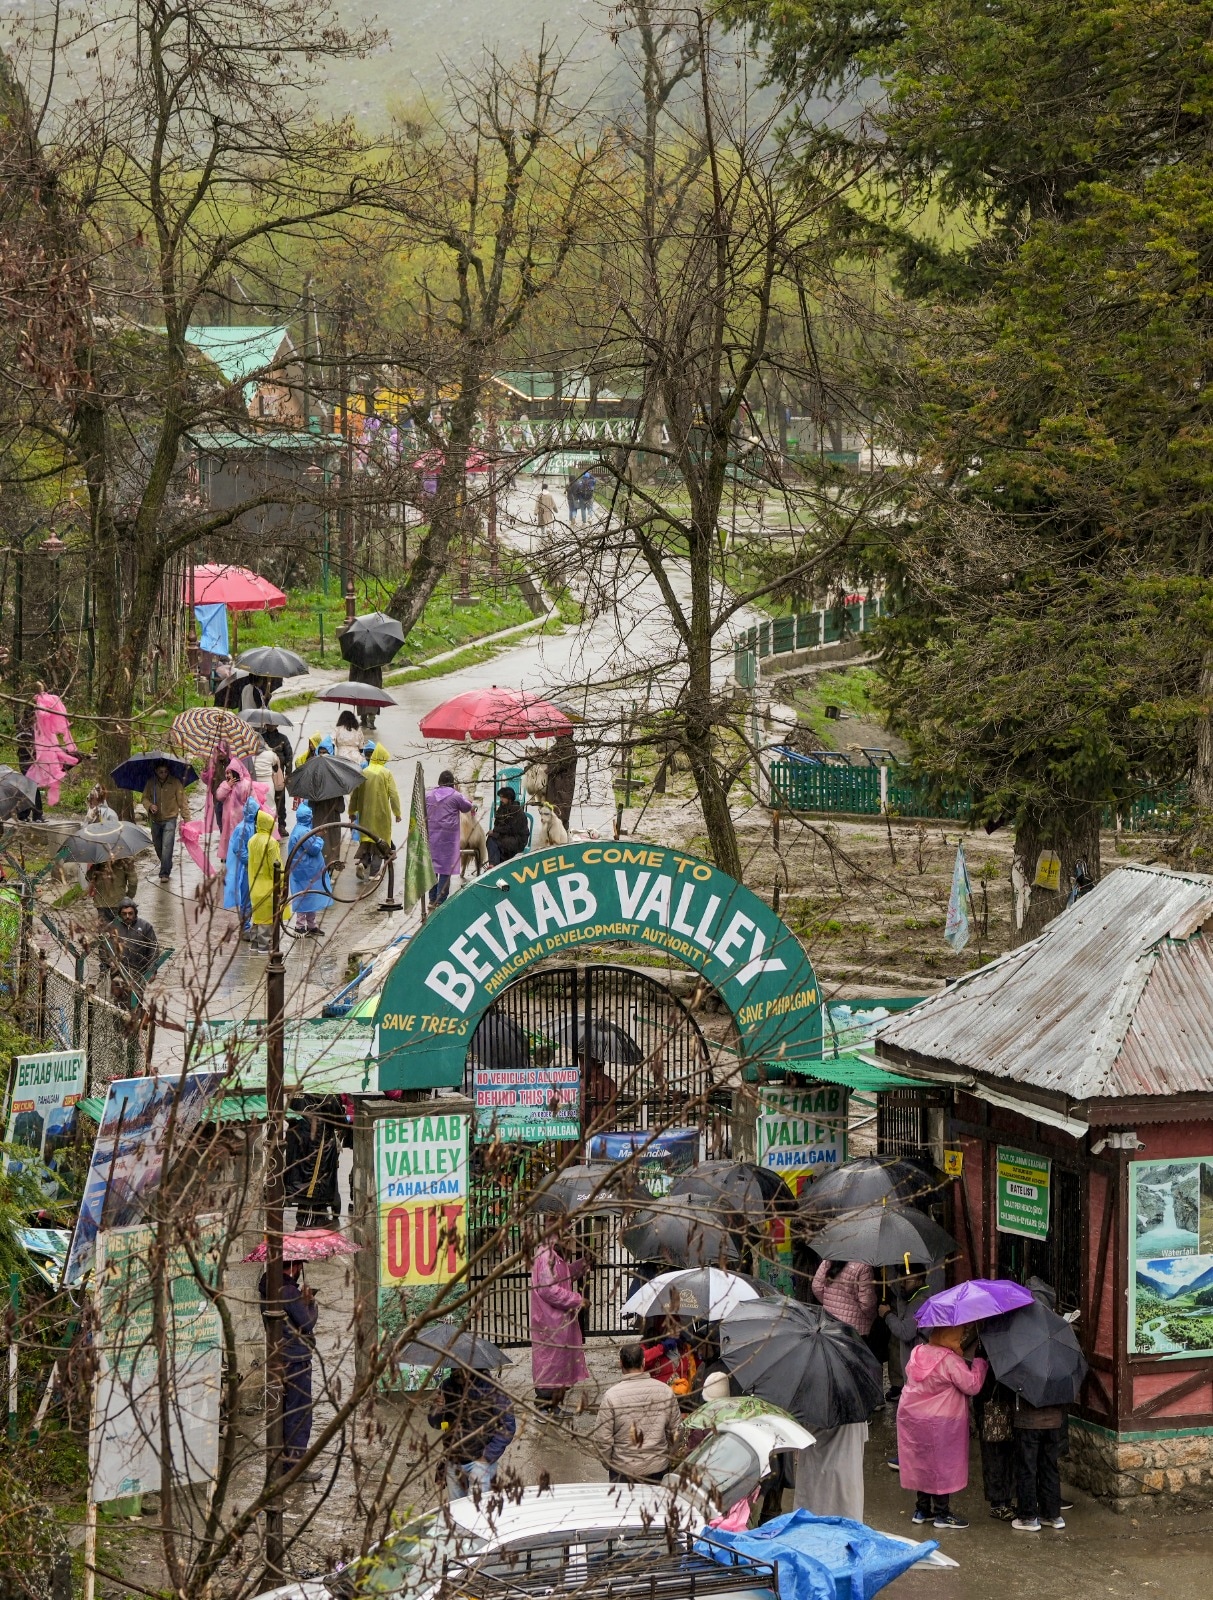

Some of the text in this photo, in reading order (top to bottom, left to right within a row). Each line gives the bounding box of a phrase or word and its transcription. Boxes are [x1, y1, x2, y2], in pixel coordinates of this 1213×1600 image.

[511, 848, 712, 884] WEL COME TO
[424, 869, 788, 1014] BETAAB VALLEY
[484, 922, 712, 995] PAHALGAM DEVELOPMENT AUTHORITY
[739, 989, 816, 1025] SAVE PAHALGAM
[381, 1013, 469, 1035] SAVE TREES
[18, 1058, 82, 1086] BETAAB VALLEY
[477, 1070, 578, 1085] NO VEHICLE IS ALLOWED
[477, 1090, 517, 1106] BEHIND
[519, 1089, 543, 1105] THIS
[766, 1089, 839, 1116] BETAAB
[385, 1116, 461, 1144] BETAAB
[507, 1126, 536, 1138] VALLEY
[537, 1125, 578, 1137] PAHALGAM
[766, 1119, 838, 1147] VALLEY
[385, 1148, 461, 1177] VALLEY
[768, 1149, 837, 1166] PAHALGAM
[388, 1179, 459, 1197] PAHALGAM
[1010, 1184, 1033, 1197] RATE LIST
[387, 1205, 464, 1278] OUT
[1161, 1248, 1194, 1258] Waterfall
[1135, 1342, 1188, 1353] VIEW POINT
